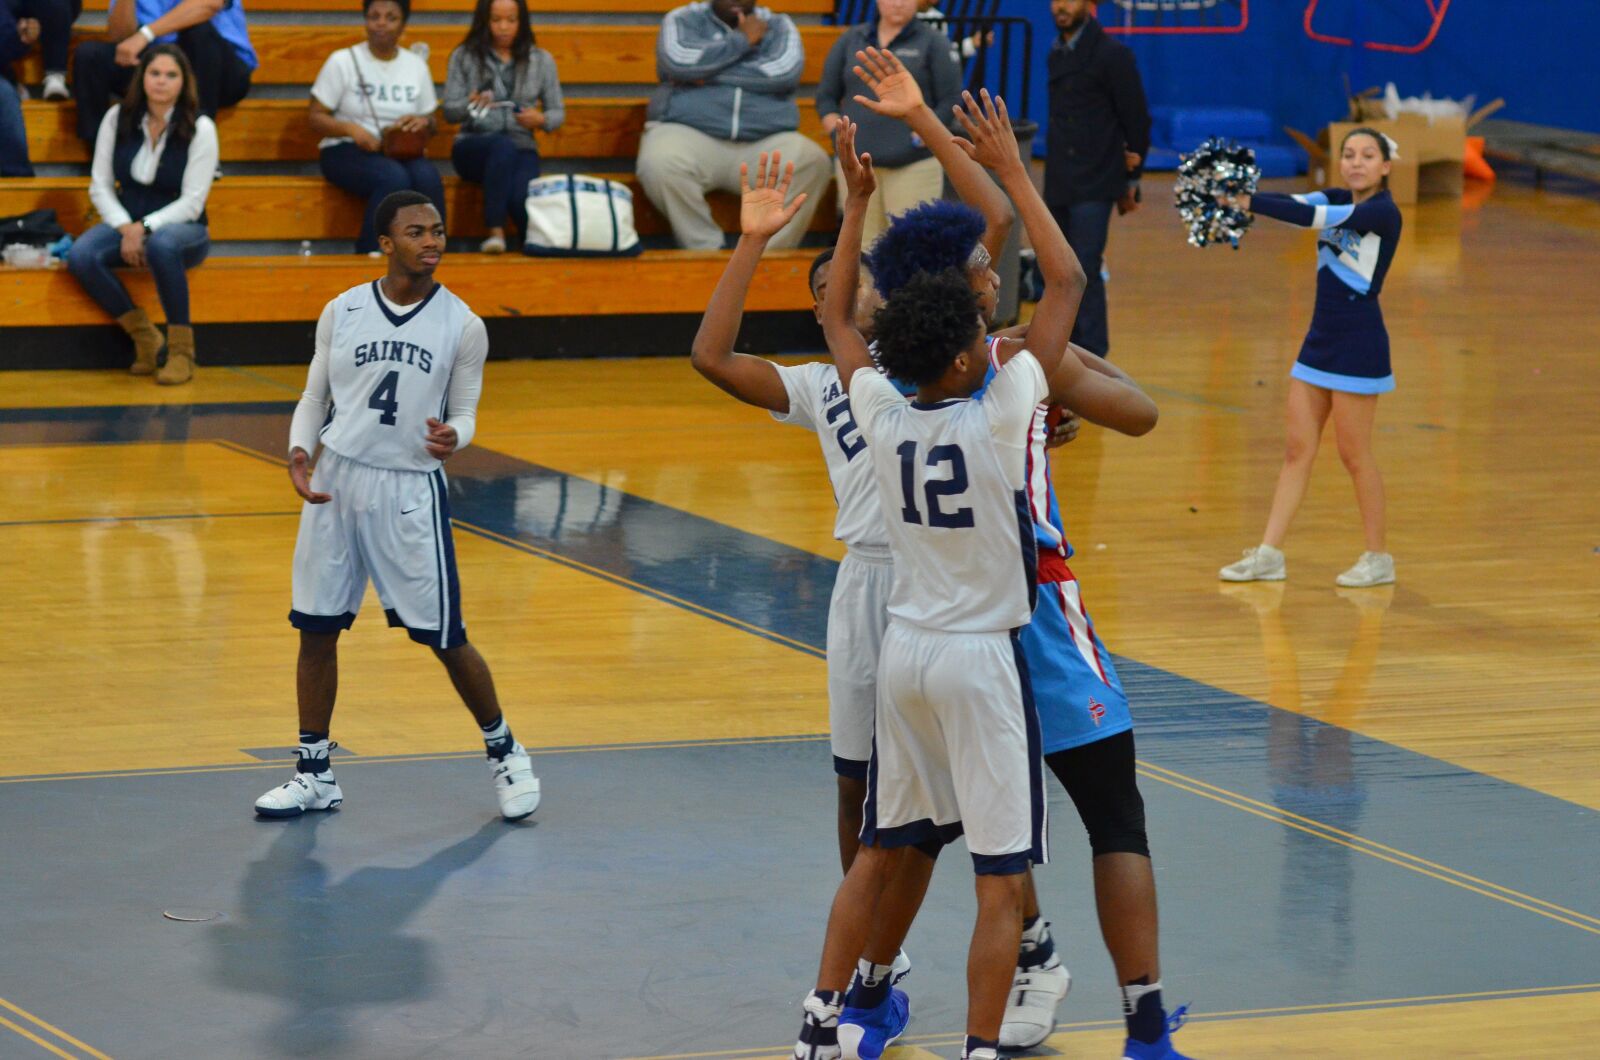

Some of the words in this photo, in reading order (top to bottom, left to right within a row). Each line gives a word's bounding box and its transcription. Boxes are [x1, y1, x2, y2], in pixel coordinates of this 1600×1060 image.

[355, 341, 433, 374] SAINTS
[368, 370, 400, 426] 4
[826, 398, 868, 463] 2
[896, 440, 975, 528] 12
